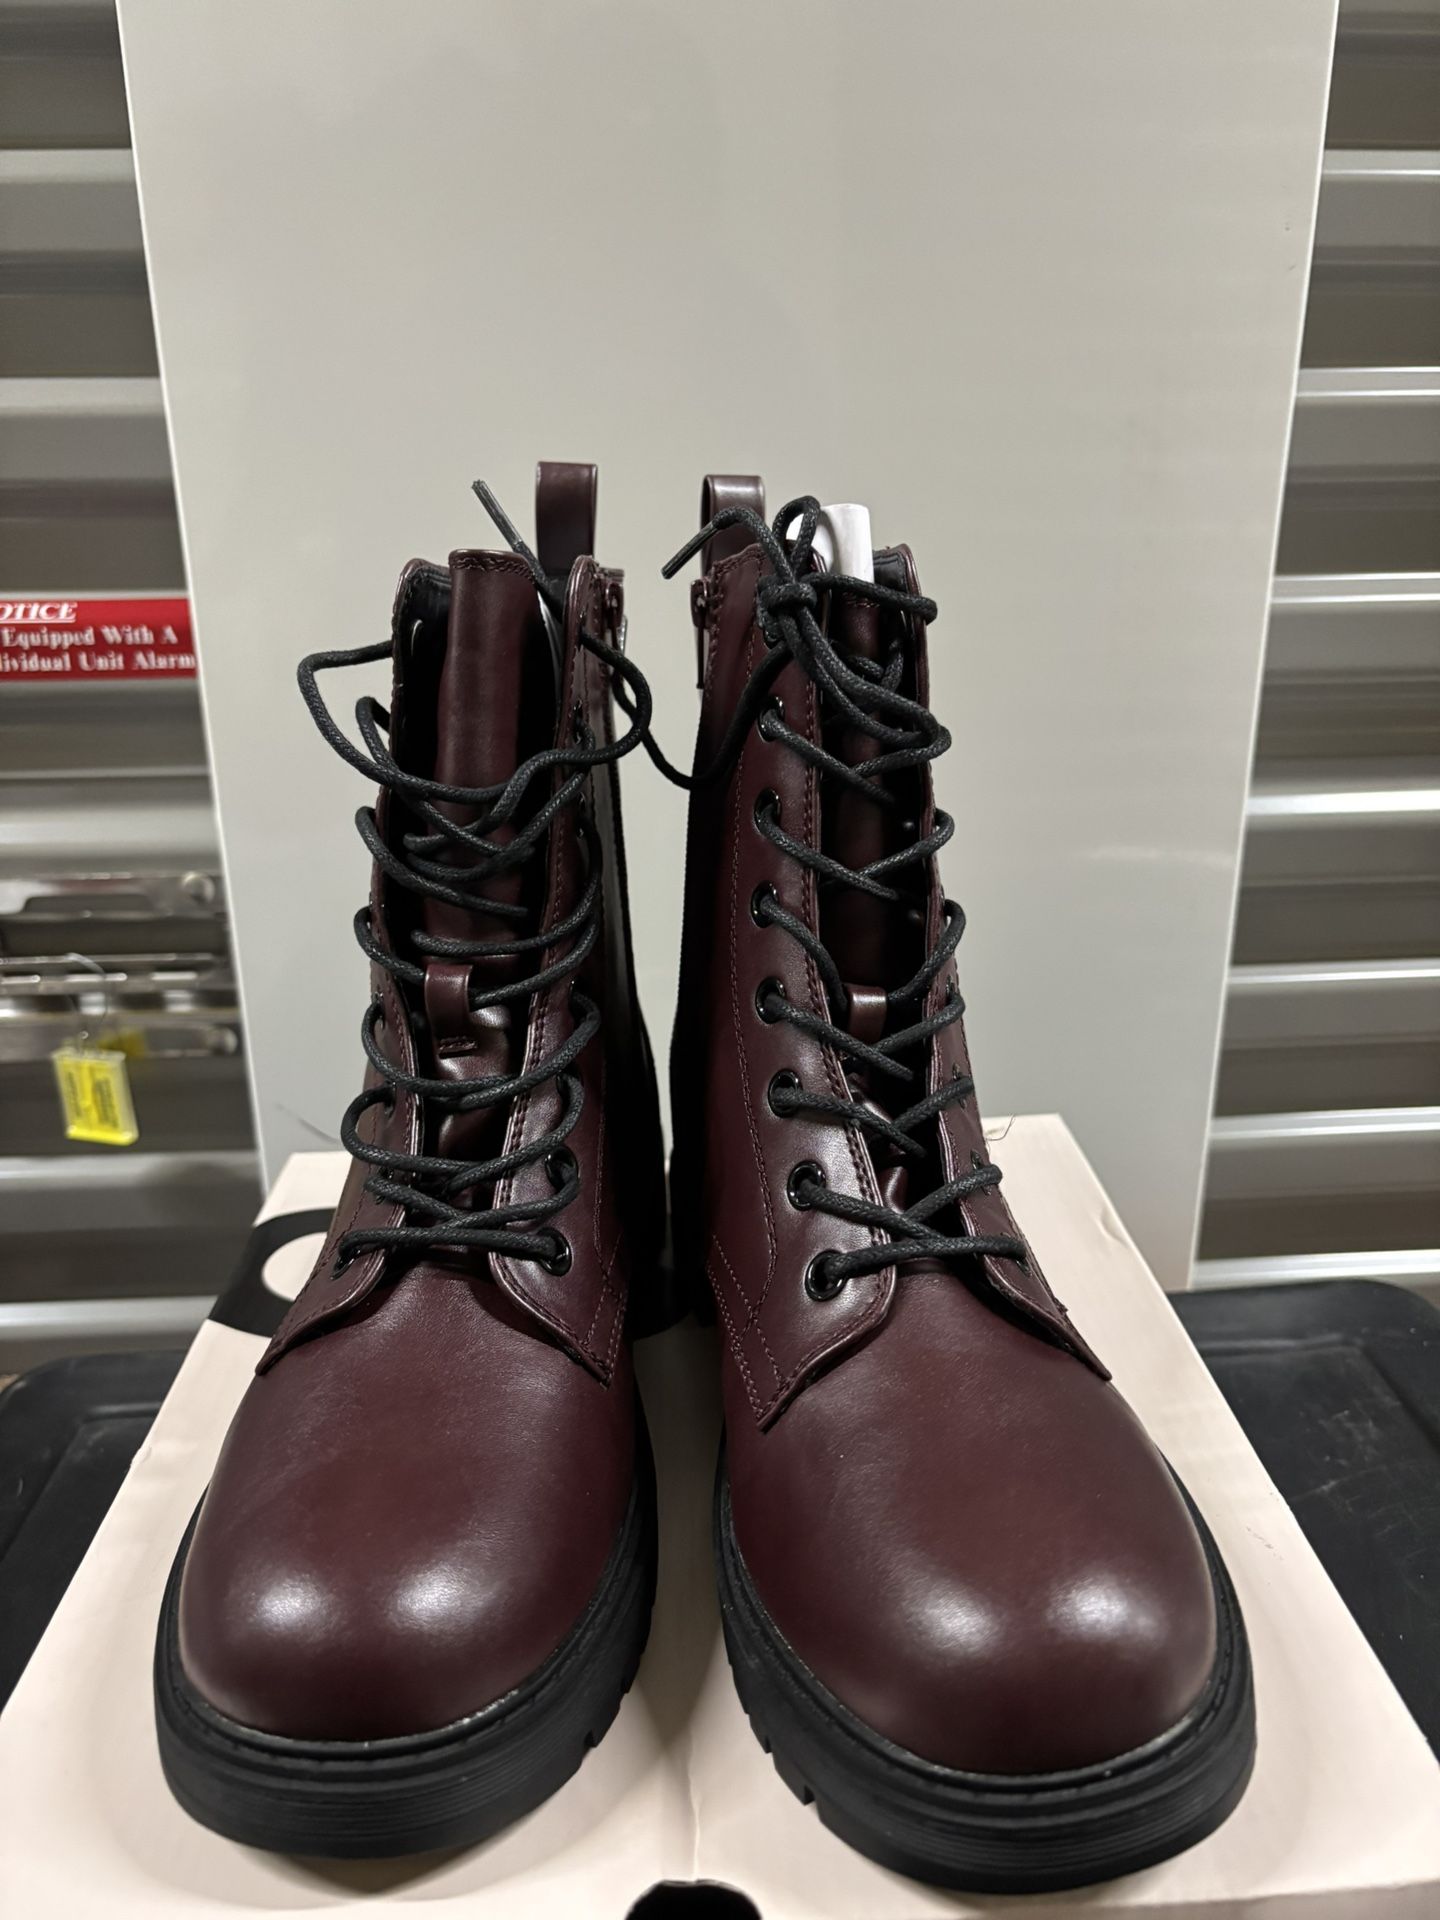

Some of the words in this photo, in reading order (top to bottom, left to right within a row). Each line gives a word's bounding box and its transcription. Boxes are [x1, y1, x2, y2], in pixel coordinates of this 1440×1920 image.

[1, 626, 95, 650] Equipped
[100, 625, 154, 645] With
[160, 625, 178, 645] A
[0, 652, 71, 672] ividual
[78, 651, 124, 671] Unit
[132, 650, 196, 670] Alarm
